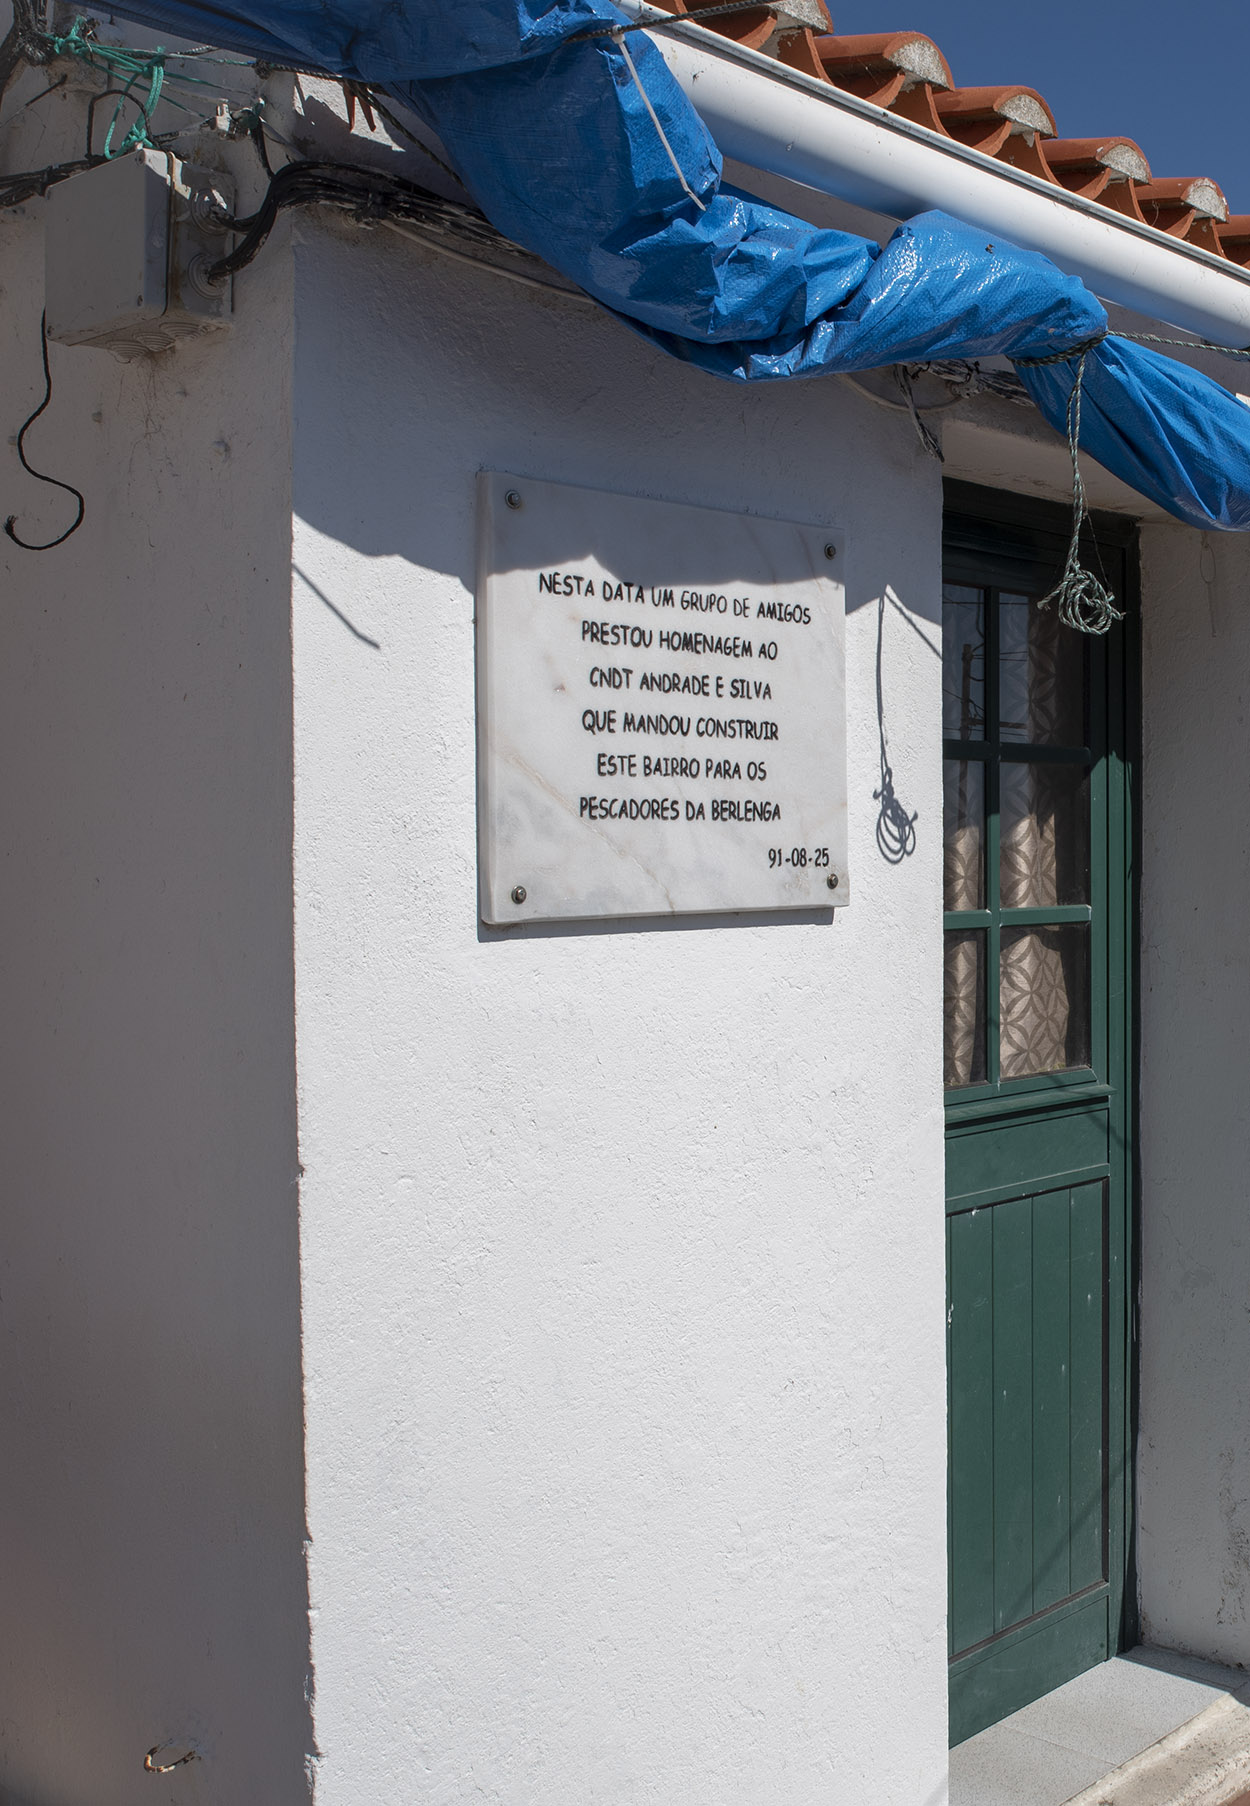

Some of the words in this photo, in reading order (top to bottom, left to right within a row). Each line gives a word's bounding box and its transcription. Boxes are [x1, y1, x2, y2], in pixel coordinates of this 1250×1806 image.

[539, 572, 594, 596] NESTA
[603, 581, 644, 604] DATA
[652, 587, 674, 607] UM
[681, 591, 727, 613] GRUPO
[734, 598, 750, 618] DE
[757, 602, 811, 625] AMIGOS
[582, 620, 652, 648] PRESTOU
[660, 630, 752, 658] HOMENAGEM
[758, 641, 778, 660] AO
[590, 667, 633, 689] CNDT
[640, 672, 709, 696] ANDRADE
[716, 676, 724, 698] E
[730, 679, 771, 700] SILVA
[582, 709, 616, 735] QUE
[623, 712, 690, 736] MANDOU
[696, 717, 778, 740] CONSTRUIR
[597, 753, 636, 777] ESTE
[644, 756, 700, 779] BAIRRO
[706, 759, 741, 779] PARA
[747, 761, 766, 781] OS
[580, 796, 679, 820] PESCADORES
[686, 801, 705, 821] DA
[712, 800, 781, 822] BERLENGA
[768, 848, 829, 868] 91-08-25
